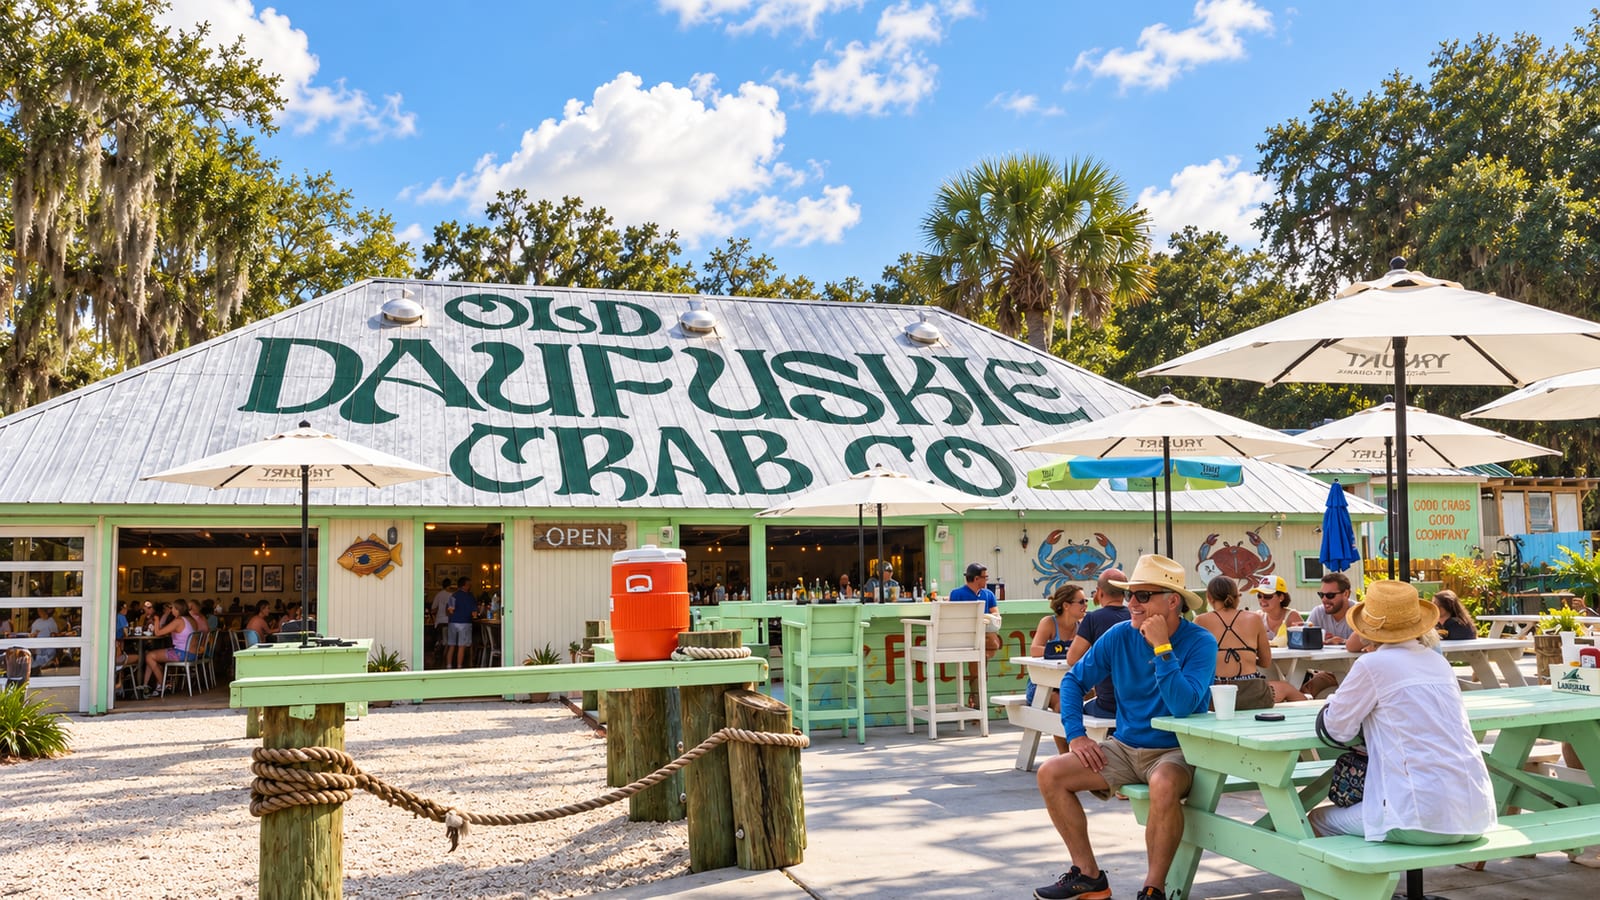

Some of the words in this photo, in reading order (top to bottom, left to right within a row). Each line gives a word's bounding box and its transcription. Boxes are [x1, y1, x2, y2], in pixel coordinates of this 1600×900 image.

[443, 292, 663, 337] OLD
[238, 336, 1092, 425] DAUFUSKIE
[449, 422, 814, 501] CRAB
[844, 435, 1017, 498] CO
[1414, 499, 1439, 511] GOOD
[1441, 499, 1471, 511] CRABS
[1429, 513, 1455, 526] GOOD
[546, 527, 612, 546] OPEN
